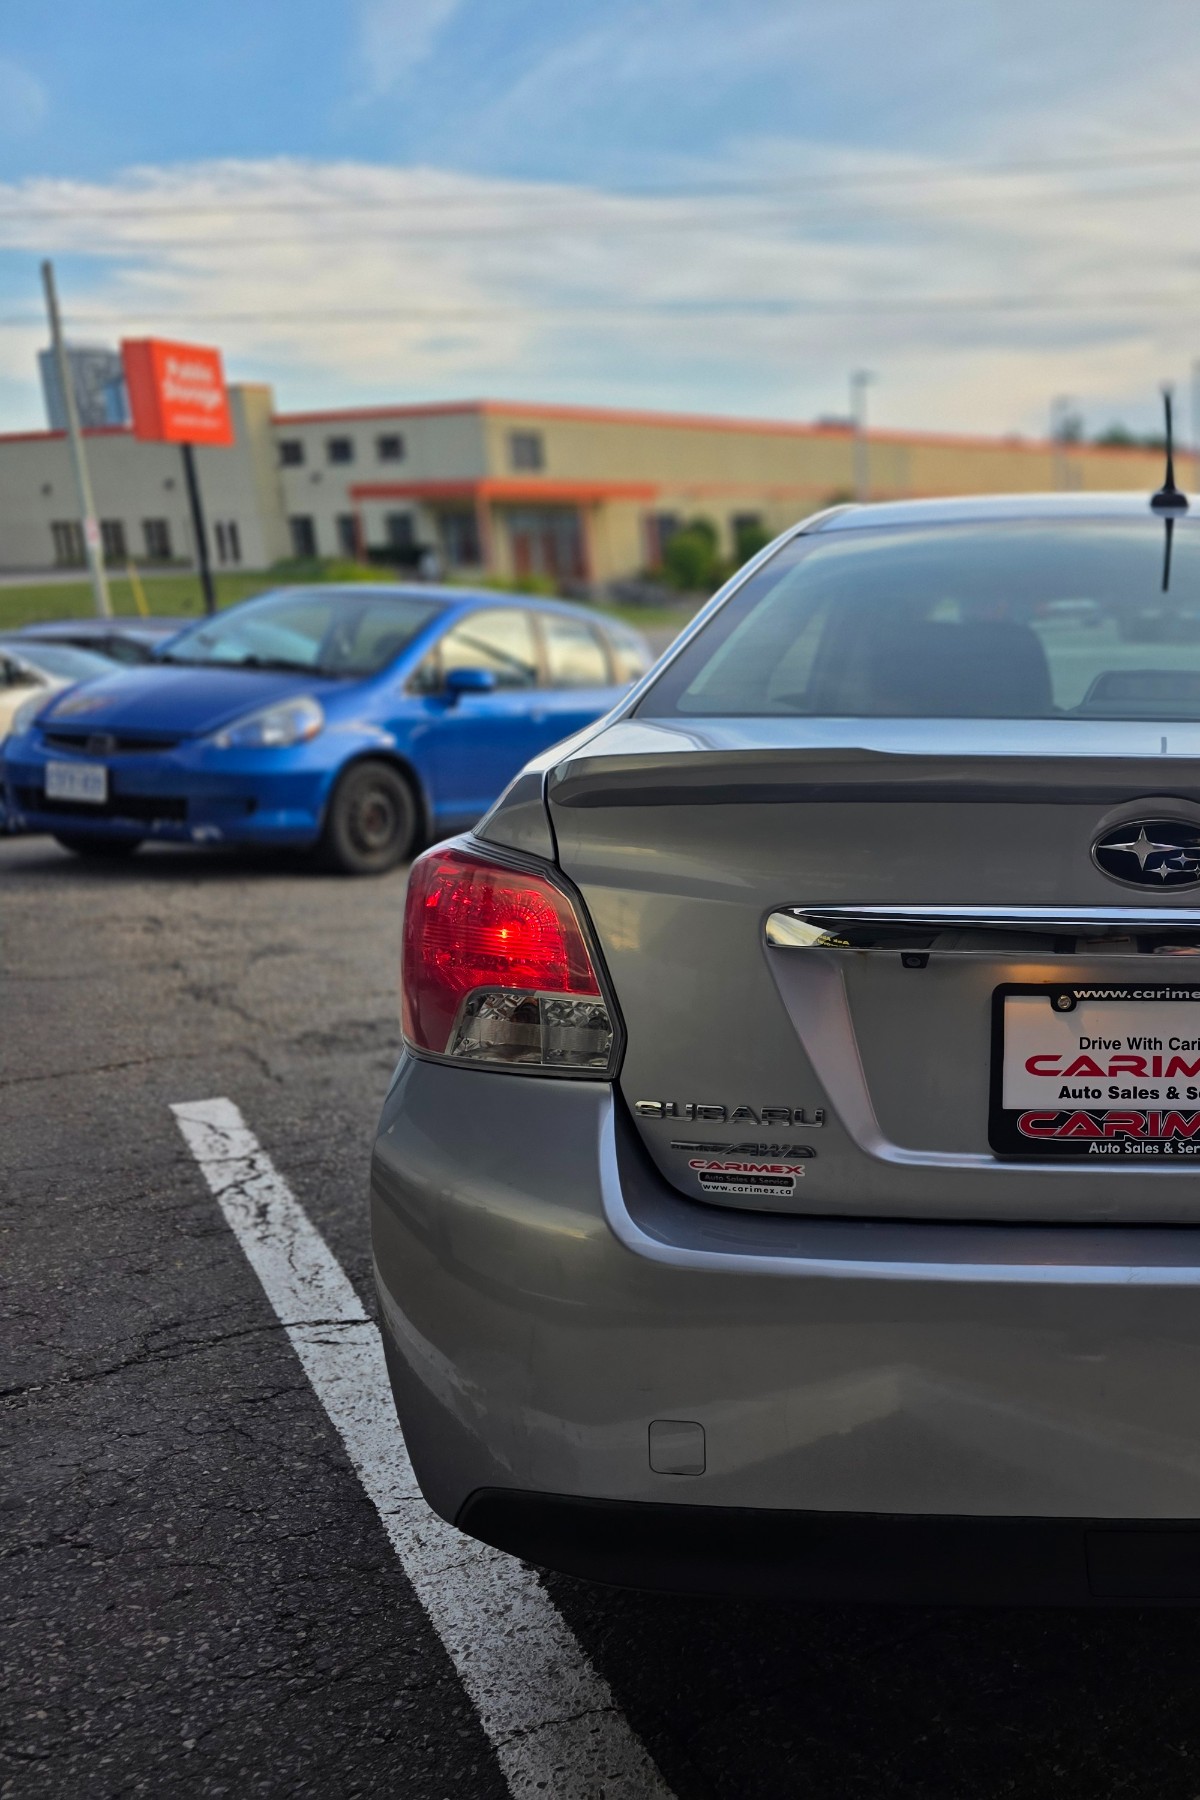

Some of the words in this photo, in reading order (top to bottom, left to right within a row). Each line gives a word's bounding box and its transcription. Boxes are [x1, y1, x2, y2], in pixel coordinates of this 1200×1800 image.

[1079, 1036, 1121, 1051] Drive
[1126, 1036, 1163, 1051] With
[1058, 1085, 1102, 1100] Auto
[1108, 1085, 1160, 1101] Sales
[1166, 1086, 1180, 1101] &
[635, 1100, 825, 1128] SUBARU
[1088, 1142, 1121, 1155] Auto
[1124, 1141, 1160, 1155] Sales
[1163, 1142, 1174, 1155] &
[689, 1160, 804, 1175] CARIMEX
[704, 1174, 724, 1182] Auto
[726, 1175, 748, 1183] Sales
[759, 1177, 790, 1185] Service
[703, 1184, 792, 1195] www.carimex.ca
